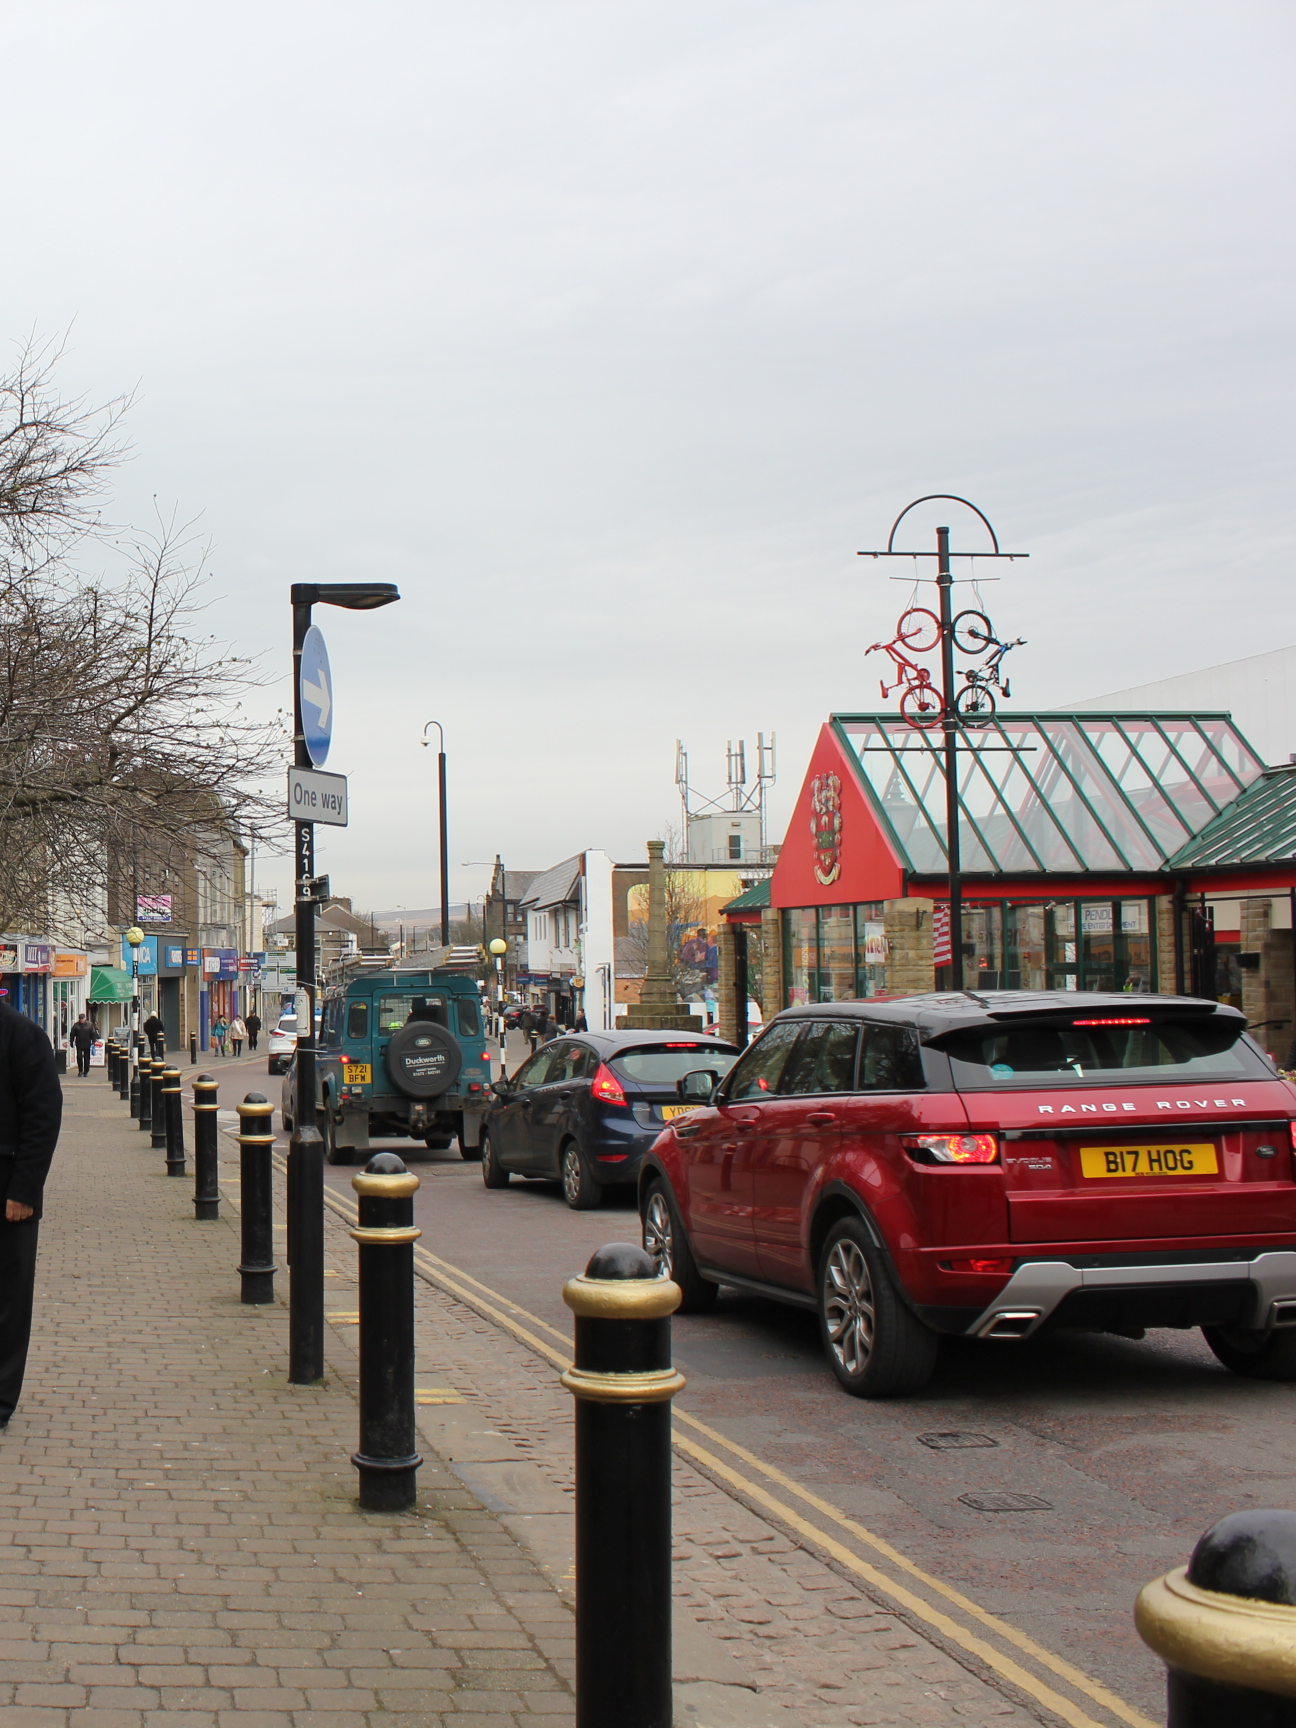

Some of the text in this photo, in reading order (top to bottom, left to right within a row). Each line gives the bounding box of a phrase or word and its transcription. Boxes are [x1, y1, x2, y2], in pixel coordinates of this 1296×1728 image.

[294, 782, 343, 815] One way
[1085, 909, 1112, 920] PENDL
[405, 1055, 445, 1065] Duckworth
[347, 1065, 367, 1074] S721
[1038, 1099, 1247, 1114] RANGE ROVER
[1104, 1149, 1194, 1173] B17 HOG
